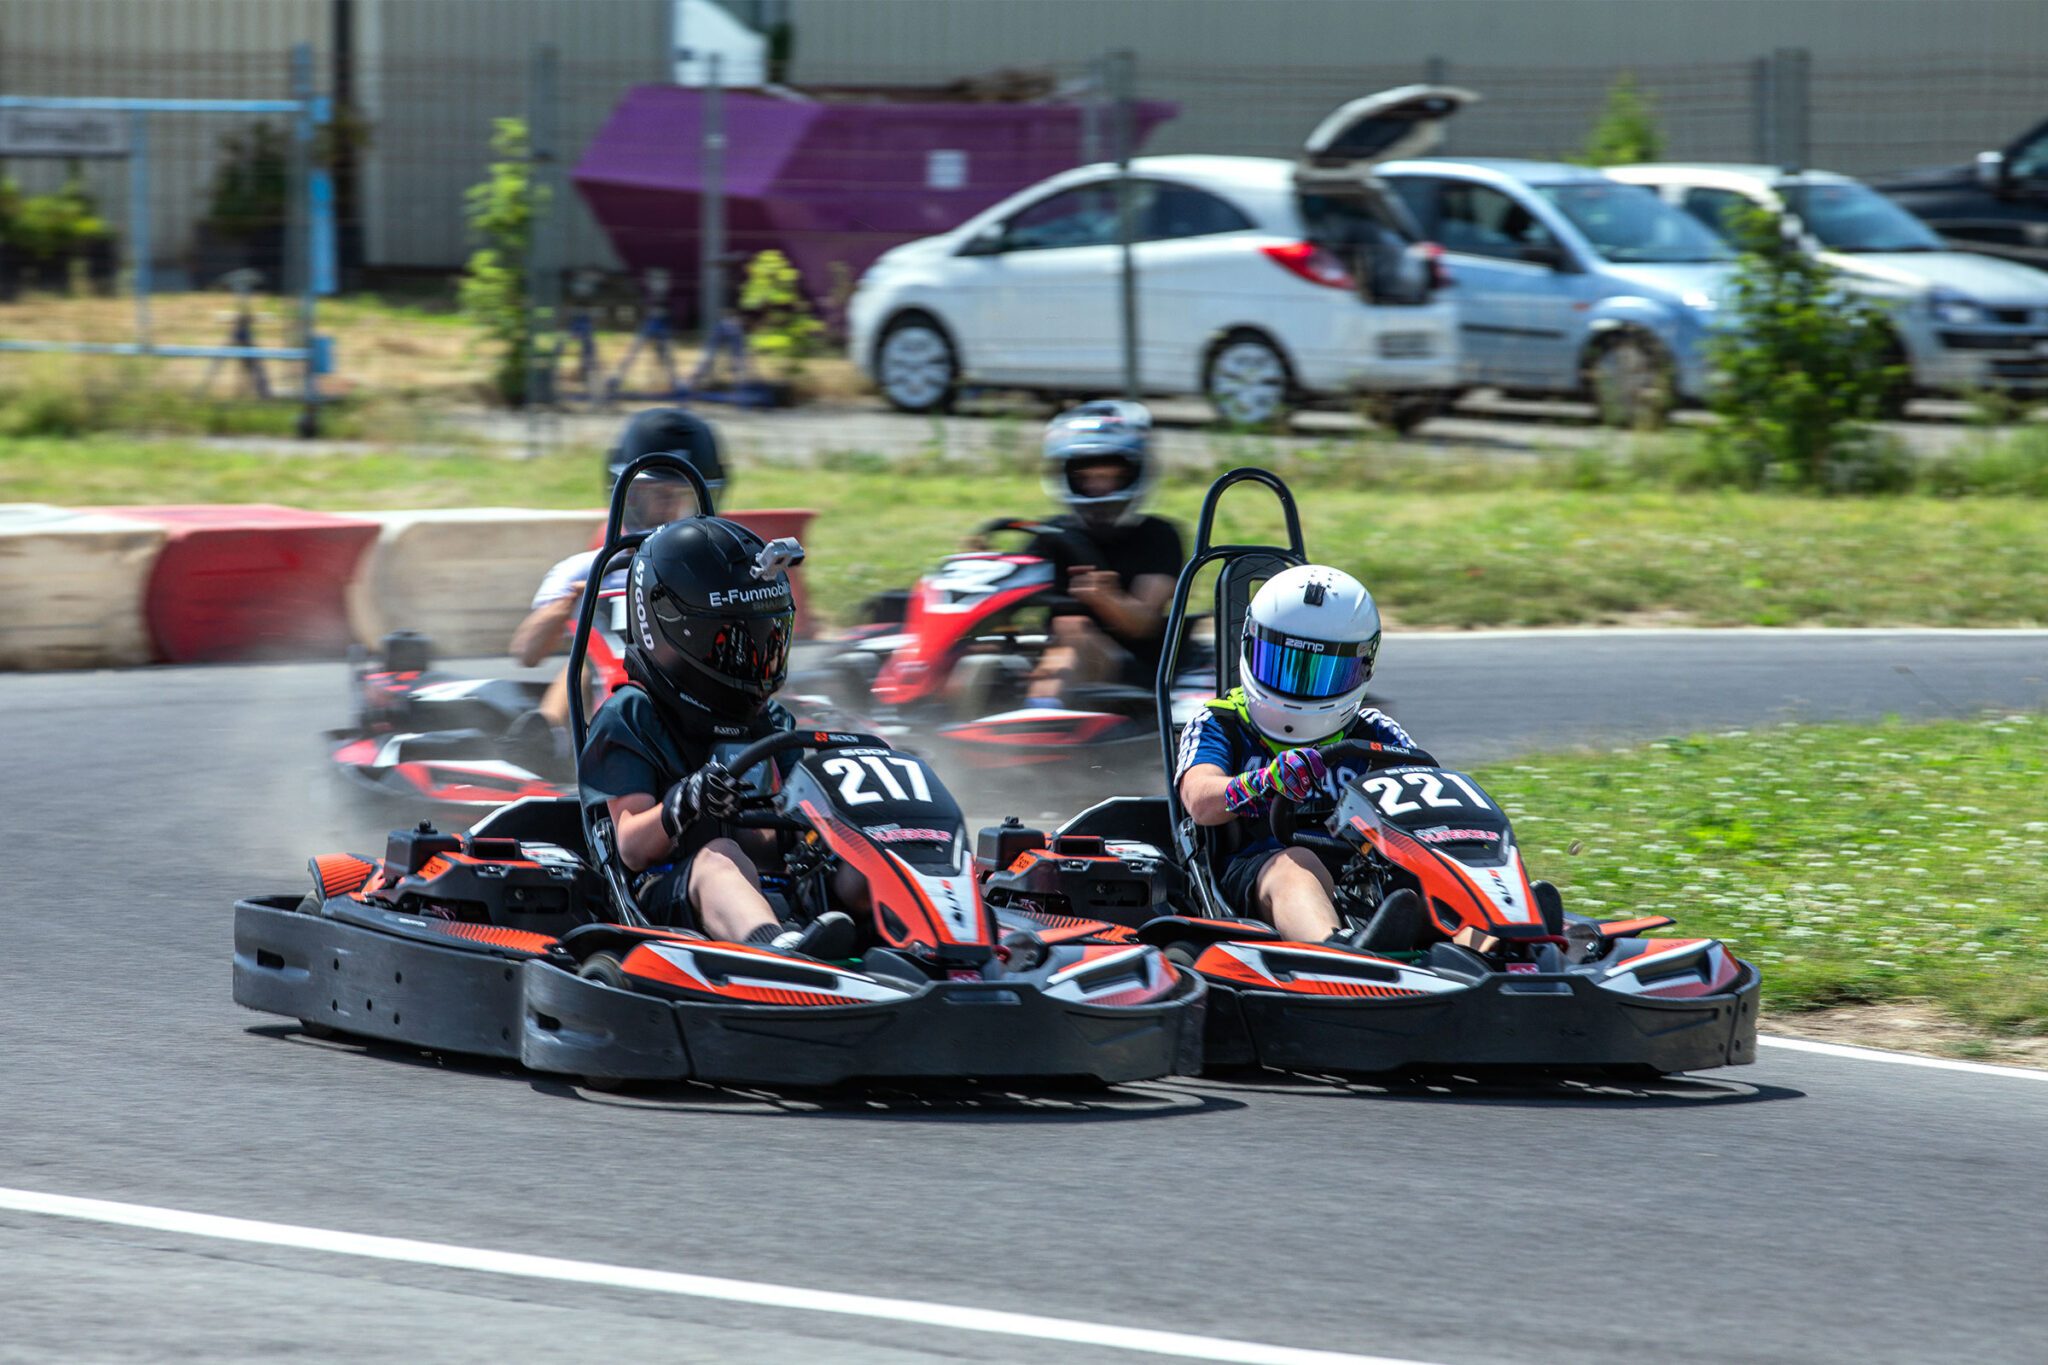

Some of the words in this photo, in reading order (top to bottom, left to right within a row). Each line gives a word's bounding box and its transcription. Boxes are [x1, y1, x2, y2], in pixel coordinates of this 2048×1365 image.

[1285, 637, 1325, 653] zamp
[822, 756, 933, 807] 217
[1362, 772, 1492, 817] 221
